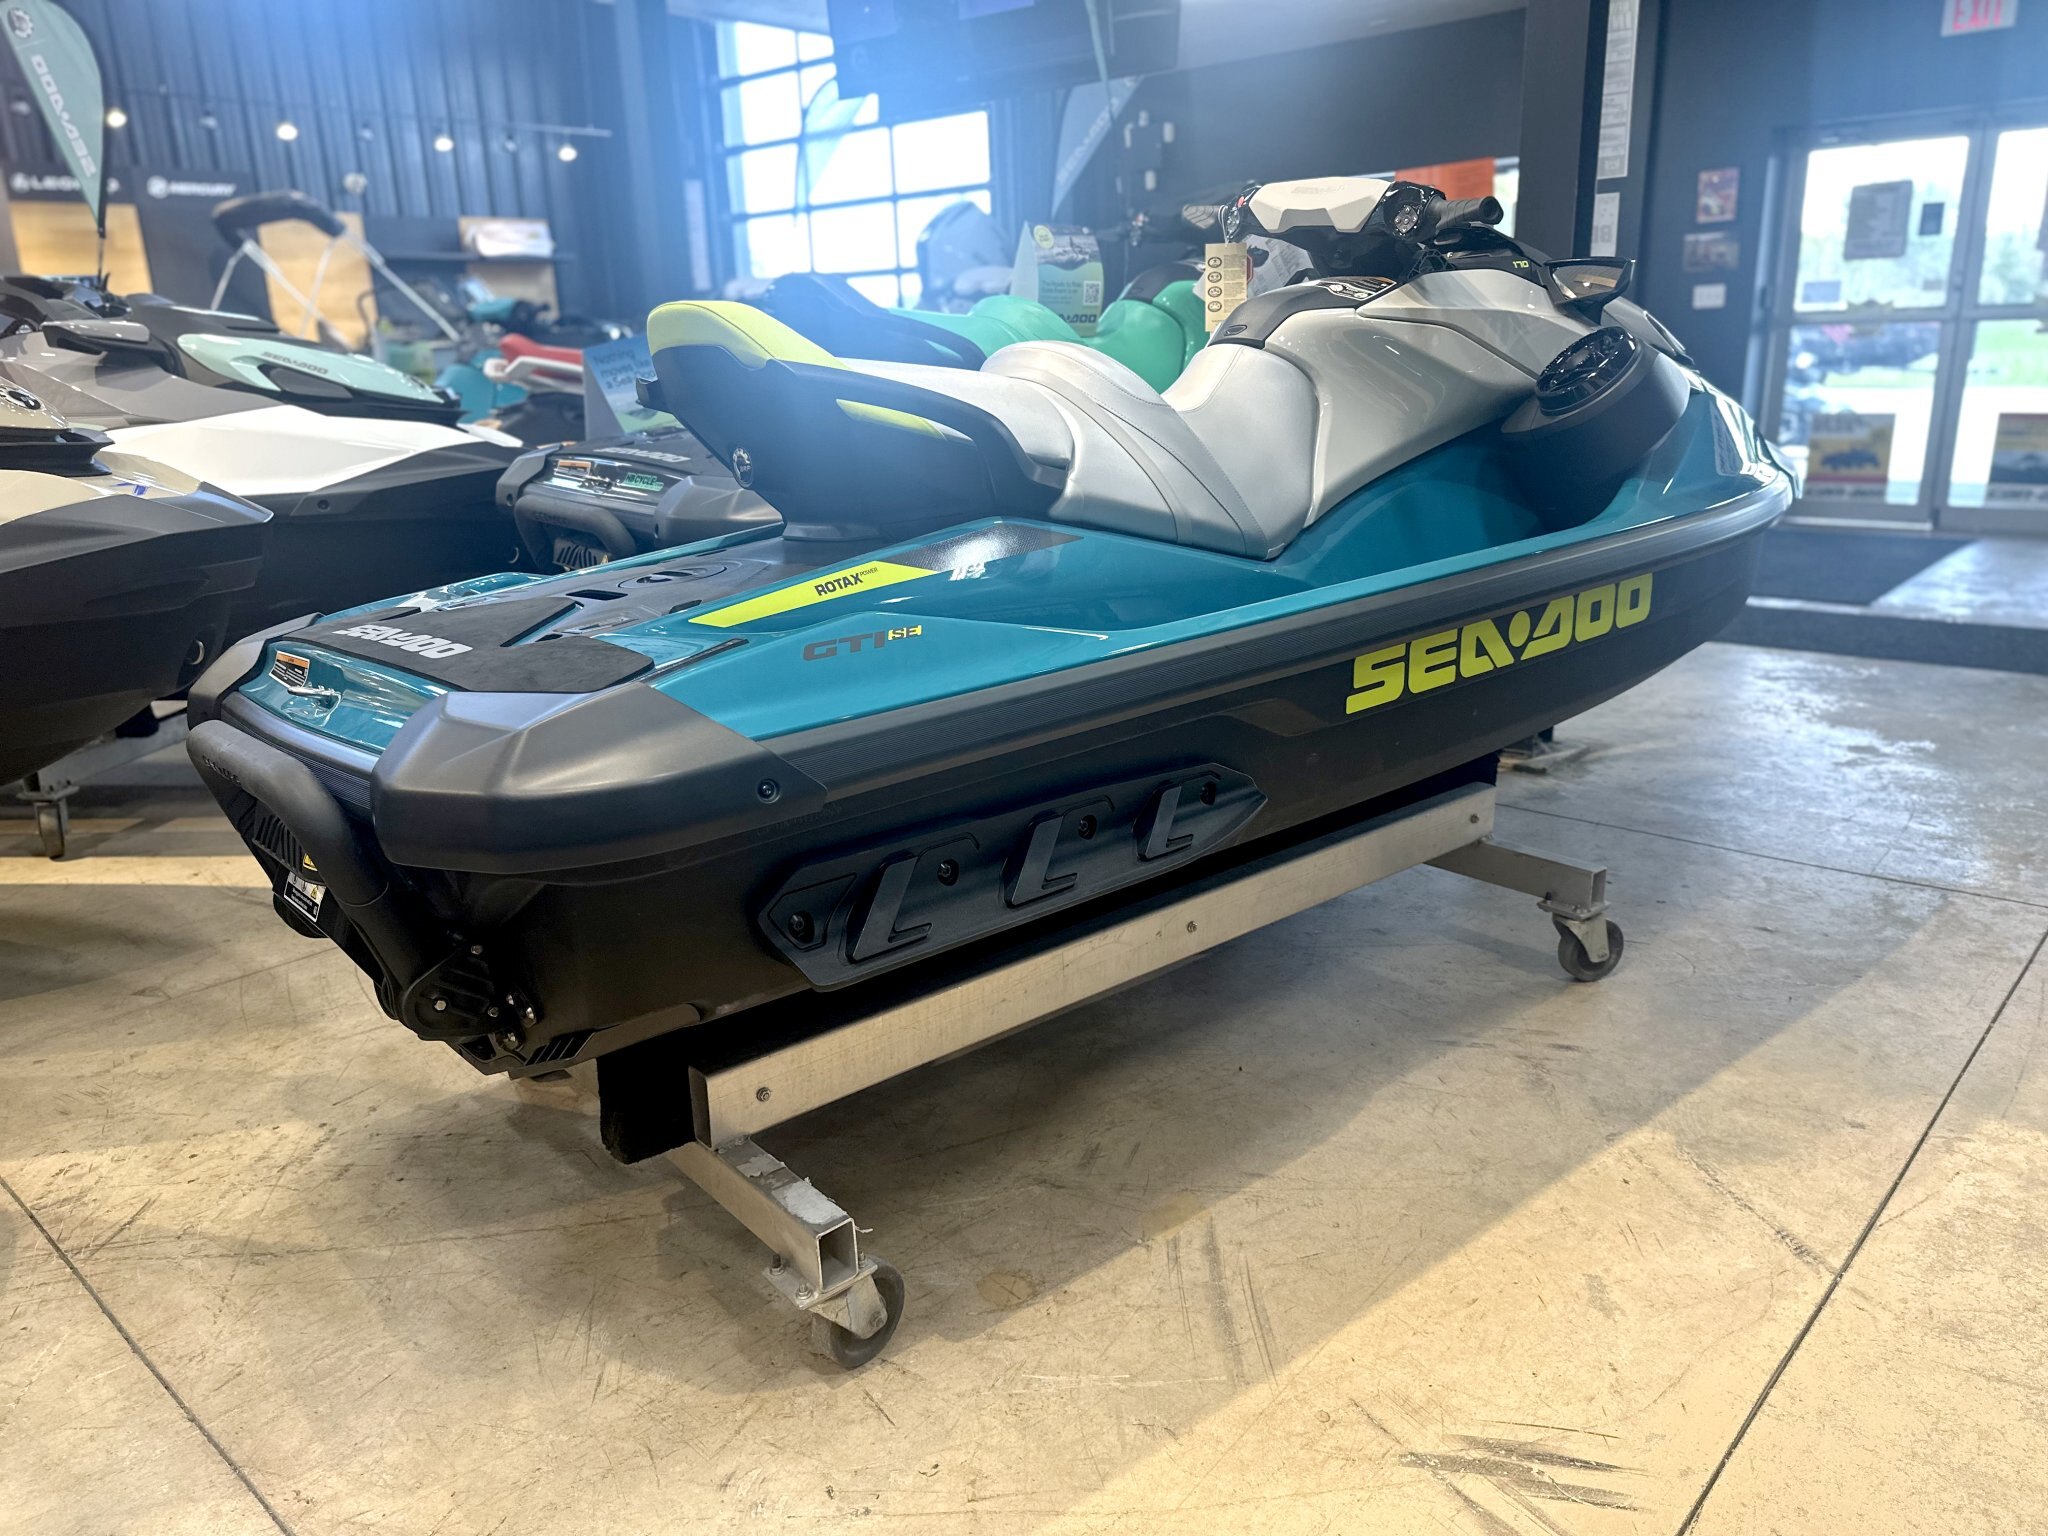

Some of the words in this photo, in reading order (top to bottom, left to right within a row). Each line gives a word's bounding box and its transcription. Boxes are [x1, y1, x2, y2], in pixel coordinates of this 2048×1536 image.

[1953, 0, 2002, 32] EXIT
[1512, 260, 1529, 268] 170
[814, 573, 864, 597] ROTAX
[859, 567, 878, 577] POWER
[803, 631, 885, 661] GTI
[890, 625, 920, 640] SE
